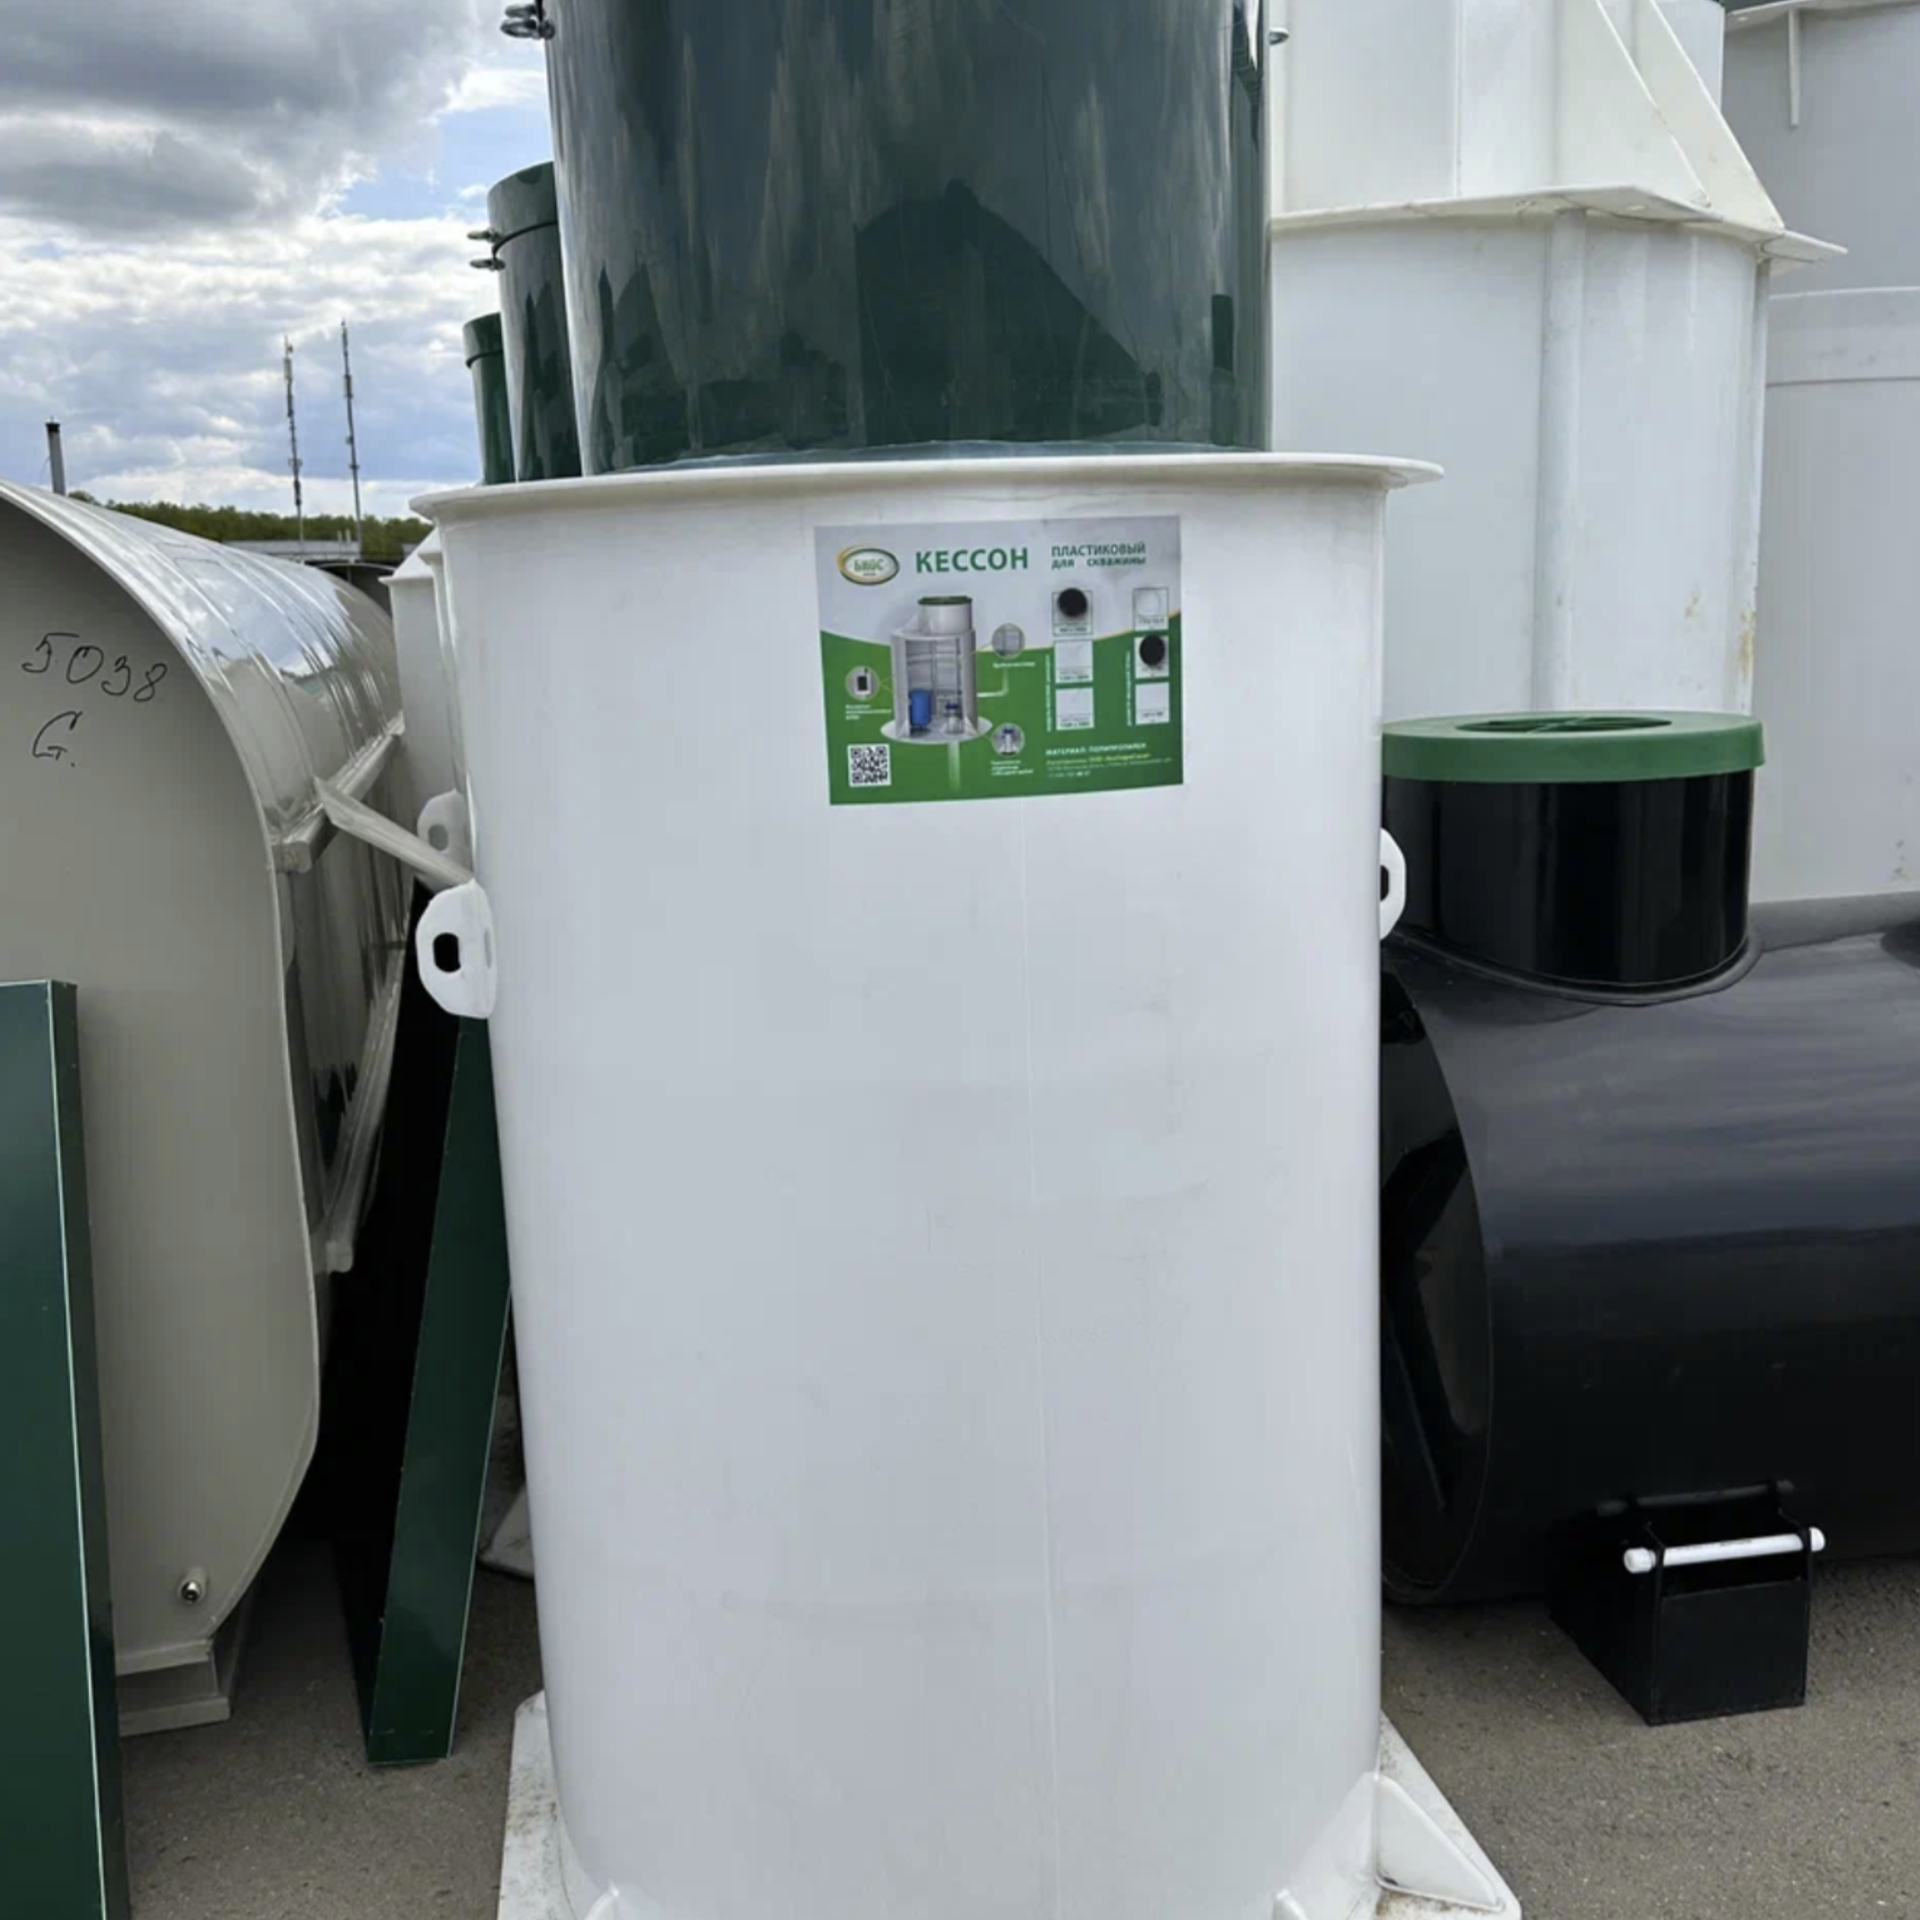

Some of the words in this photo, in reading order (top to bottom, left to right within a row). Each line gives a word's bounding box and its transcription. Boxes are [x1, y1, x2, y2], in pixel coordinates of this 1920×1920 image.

[1052, 541, 1146, 557] ПЛАСТИКОВЫЙ
[916, 548, 1028, 573] КЕССОН
[1052, 558, 1075, 570] для
[1087, 556, 1146, 568] скважины
[21, 632, 168, 702] 5038
